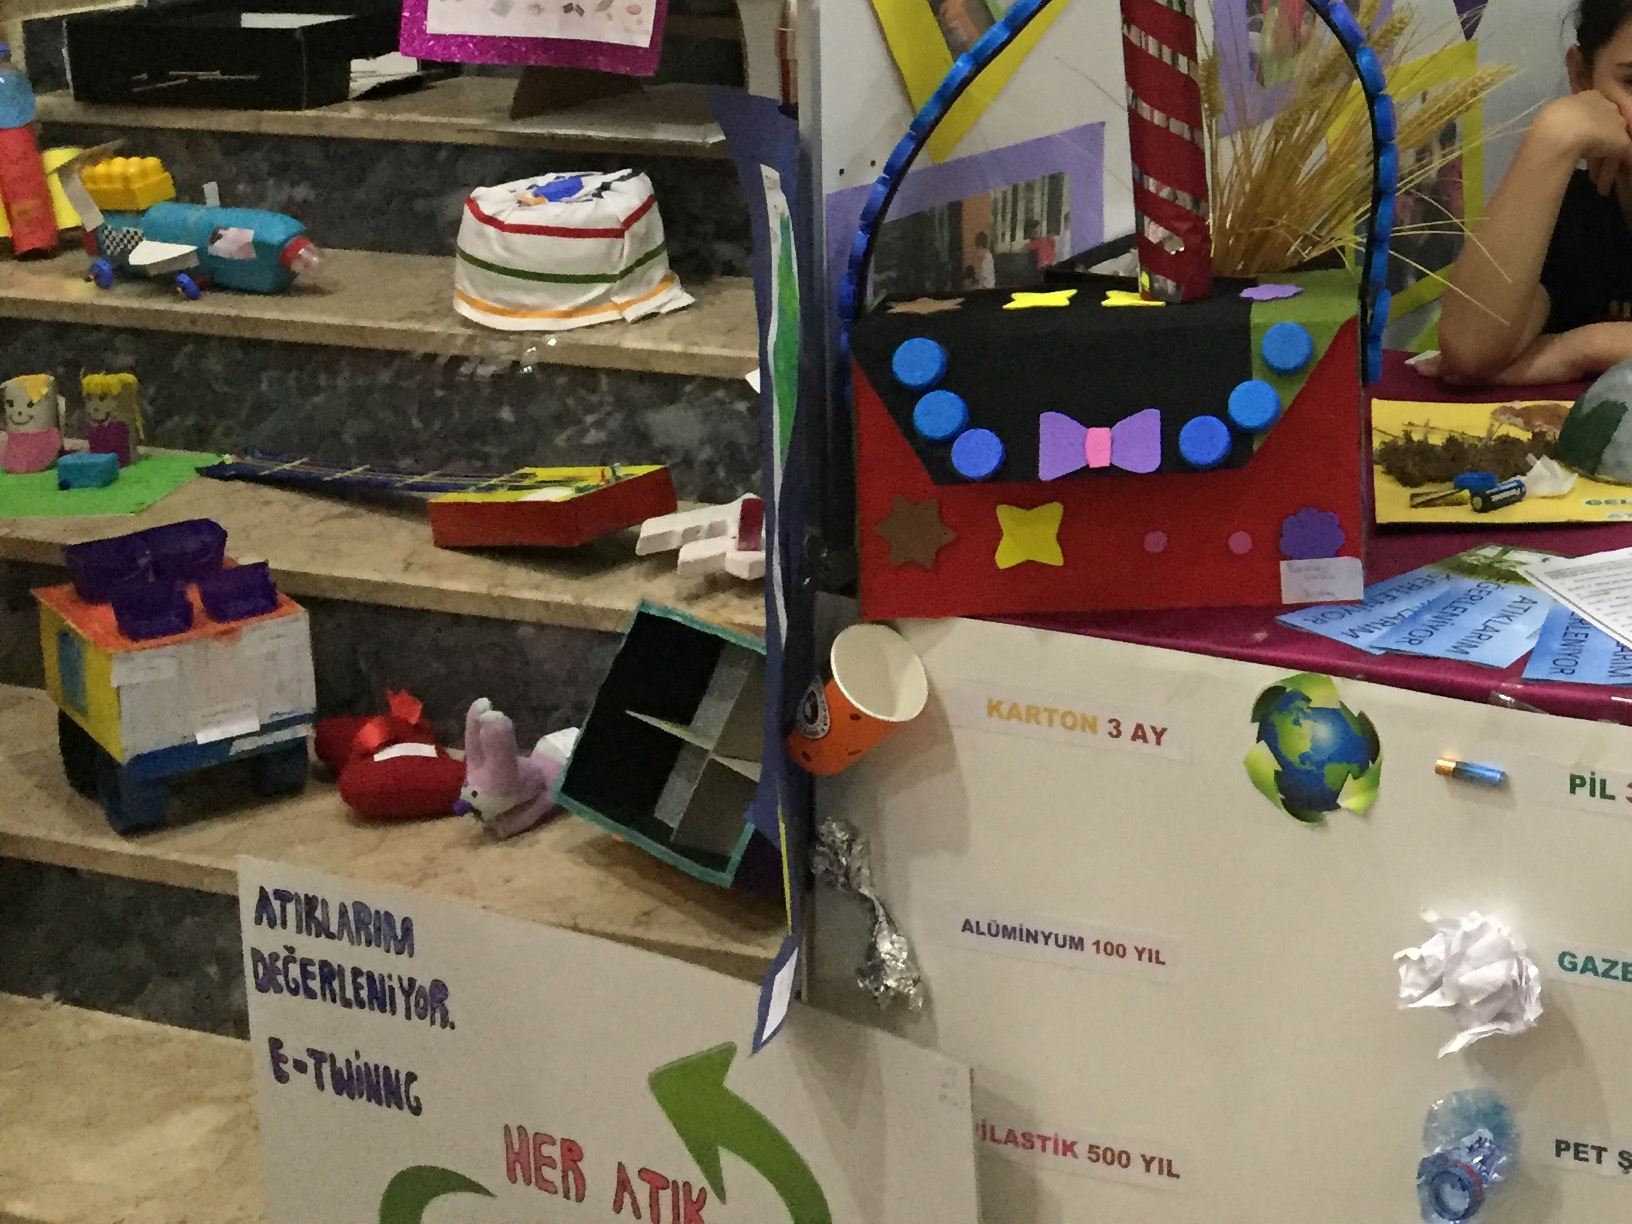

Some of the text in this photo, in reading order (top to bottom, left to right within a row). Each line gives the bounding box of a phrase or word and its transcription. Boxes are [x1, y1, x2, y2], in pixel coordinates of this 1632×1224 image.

[1446, 594, 1538, 658] ATIKLARIM
[987, 698, 1168, 746] KARTON 3 AY
[1569, 771, 1616, 800] PİL
[254, 885, 415, 958] ATIKLARIM
[961, 918, 1166, 965] ALÜMİNYUM 100 YIL
[504, 1124, 708, 1224] HER ATIK
[1087, 1143, 1131, 1169] 500
[1140, 1153, 1181, 1179] YIL
[1555, 1138, 1608, 1165] PET
